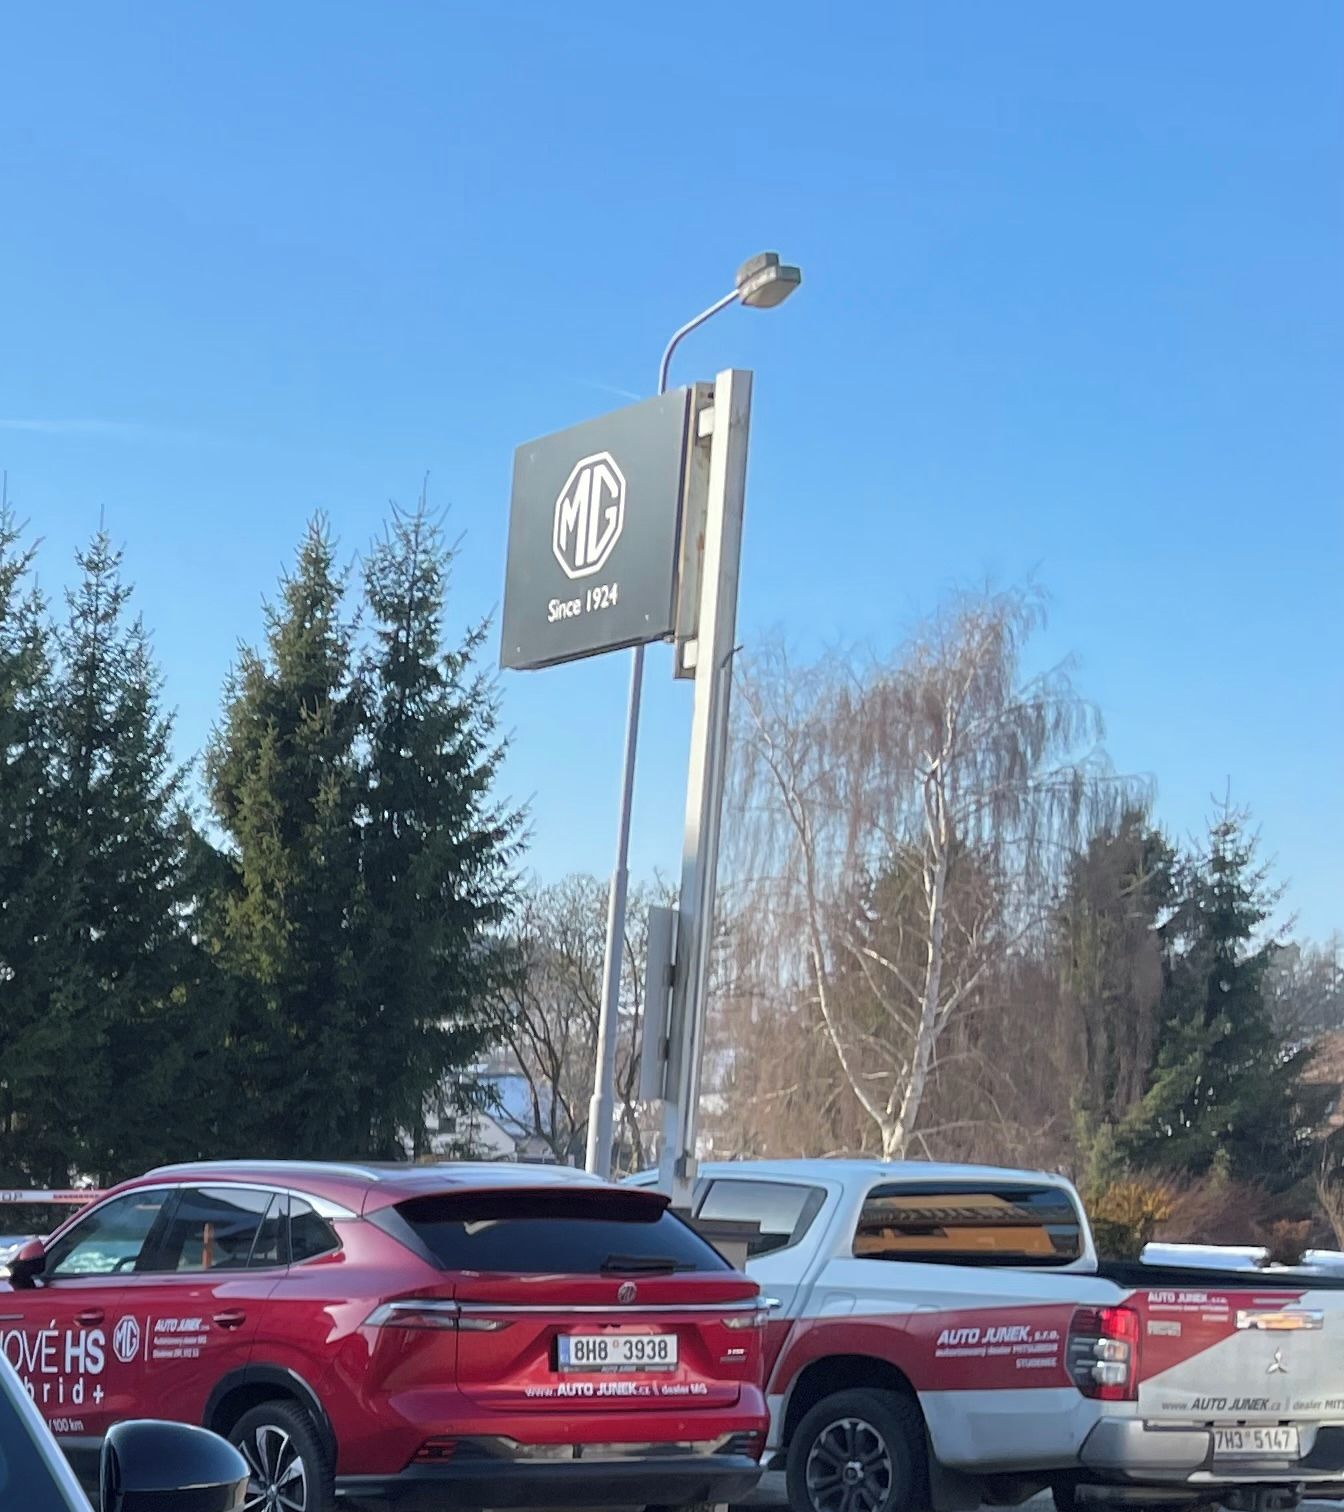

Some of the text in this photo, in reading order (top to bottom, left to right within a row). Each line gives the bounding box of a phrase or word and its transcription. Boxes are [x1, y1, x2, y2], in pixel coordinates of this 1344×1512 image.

[558, 463, 620, 568] MG
[548, 583, 619, 624] Since 1924
[64, 1329, 106, 1375] HS
[114, 1317, 139, 1360] MG
[574, 1339, 669, 1361] 8H8 3938
[937, 1327, 981, 1345] AUTO
[1215, 1430, 1292, 1450] 7H3 5147
